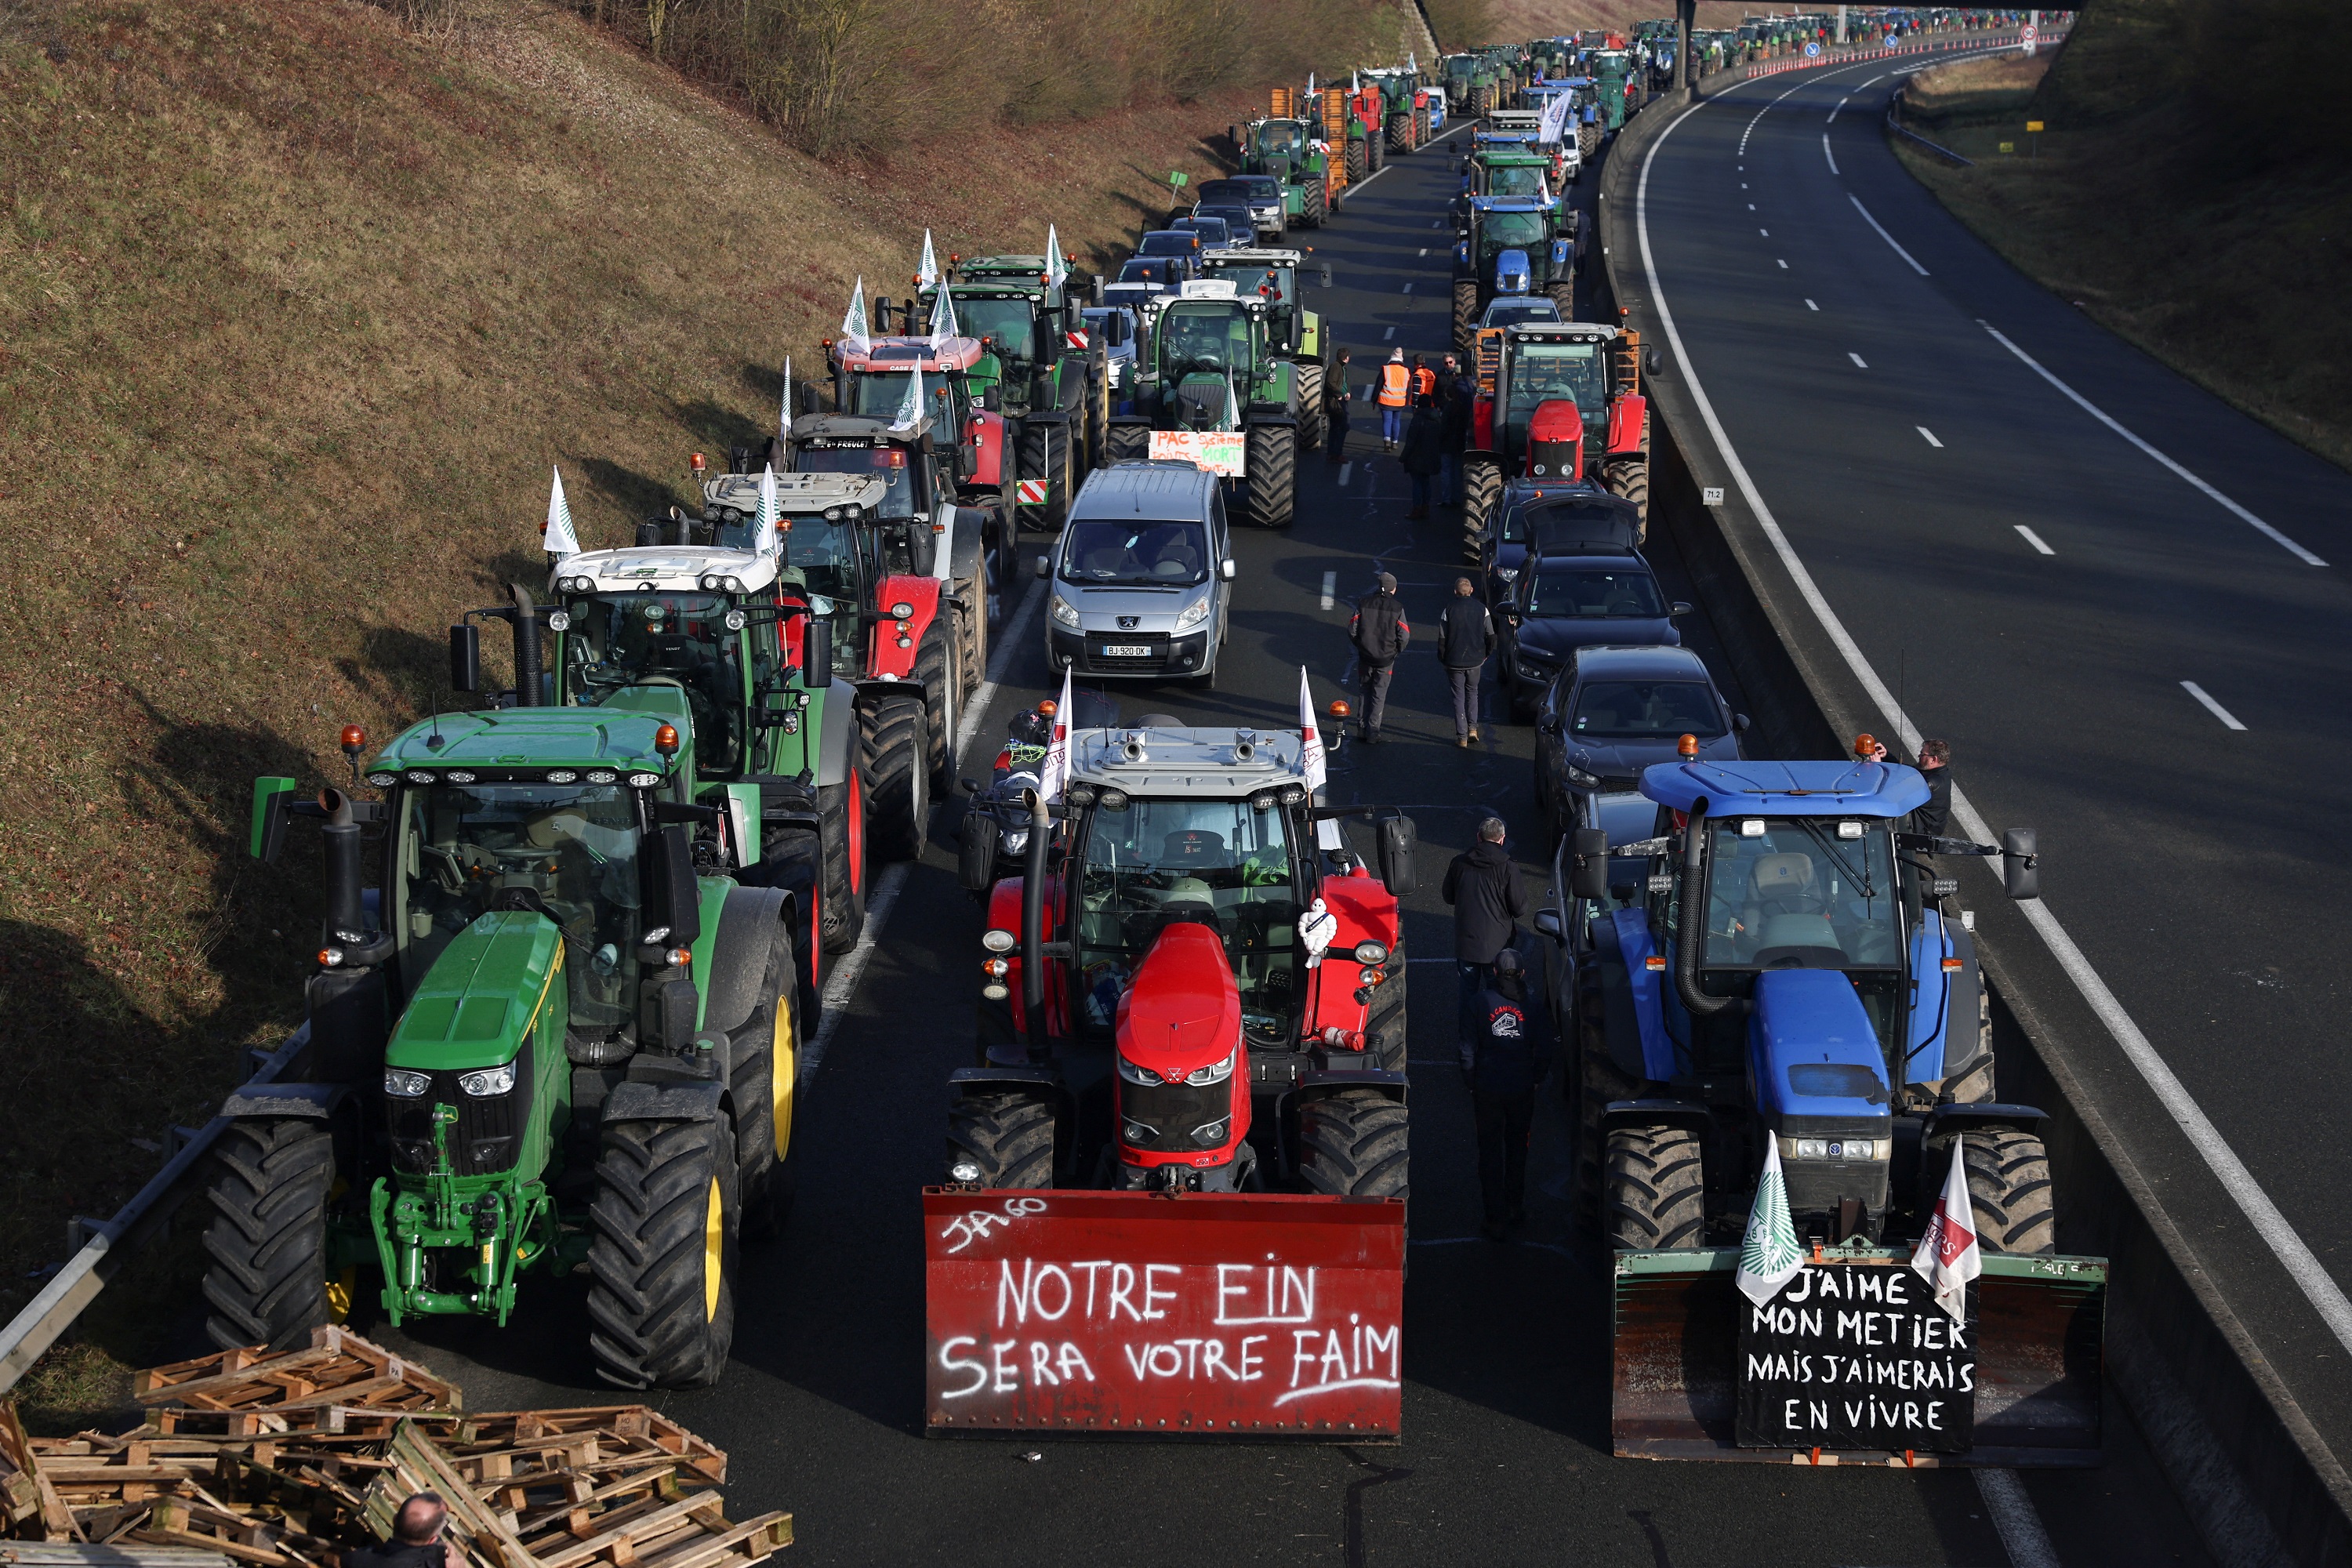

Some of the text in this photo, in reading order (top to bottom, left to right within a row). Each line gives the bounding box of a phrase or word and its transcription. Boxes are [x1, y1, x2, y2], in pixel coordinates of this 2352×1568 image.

[1157, 431, 1190, 447] PAC
[1202, 447, 1242, 463] MORT
[1494, 1005, 1526, 1022] CAMPAGNE
[997, 1258, 1182, 1329] NOTRE
[1753, 1304, 1823, 1337] MON
[939, 1334, 1095, 1399] SERA
[1125, 1334, 1268, 1383] VOTRE
[1785, 1399, 1829, 1431] EN
